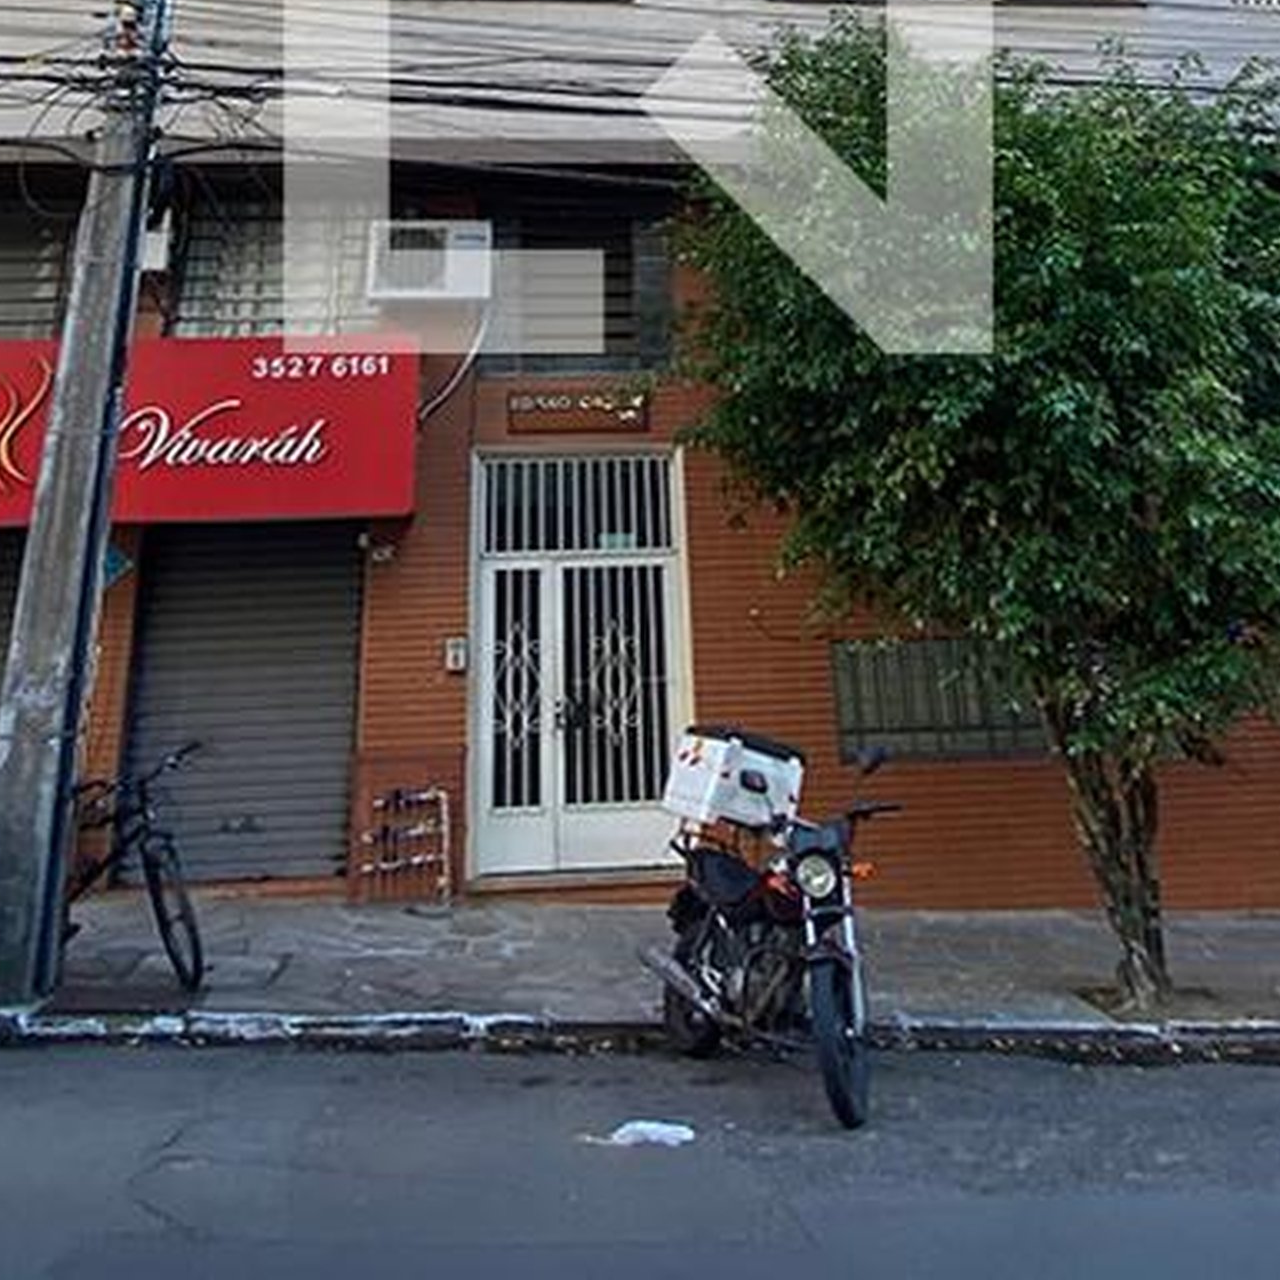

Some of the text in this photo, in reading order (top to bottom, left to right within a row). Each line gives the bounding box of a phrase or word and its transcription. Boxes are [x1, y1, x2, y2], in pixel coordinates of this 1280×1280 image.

[251, 355, 390, 379] 3527 6161
[118, 398, 329, 472] Vivaráh
